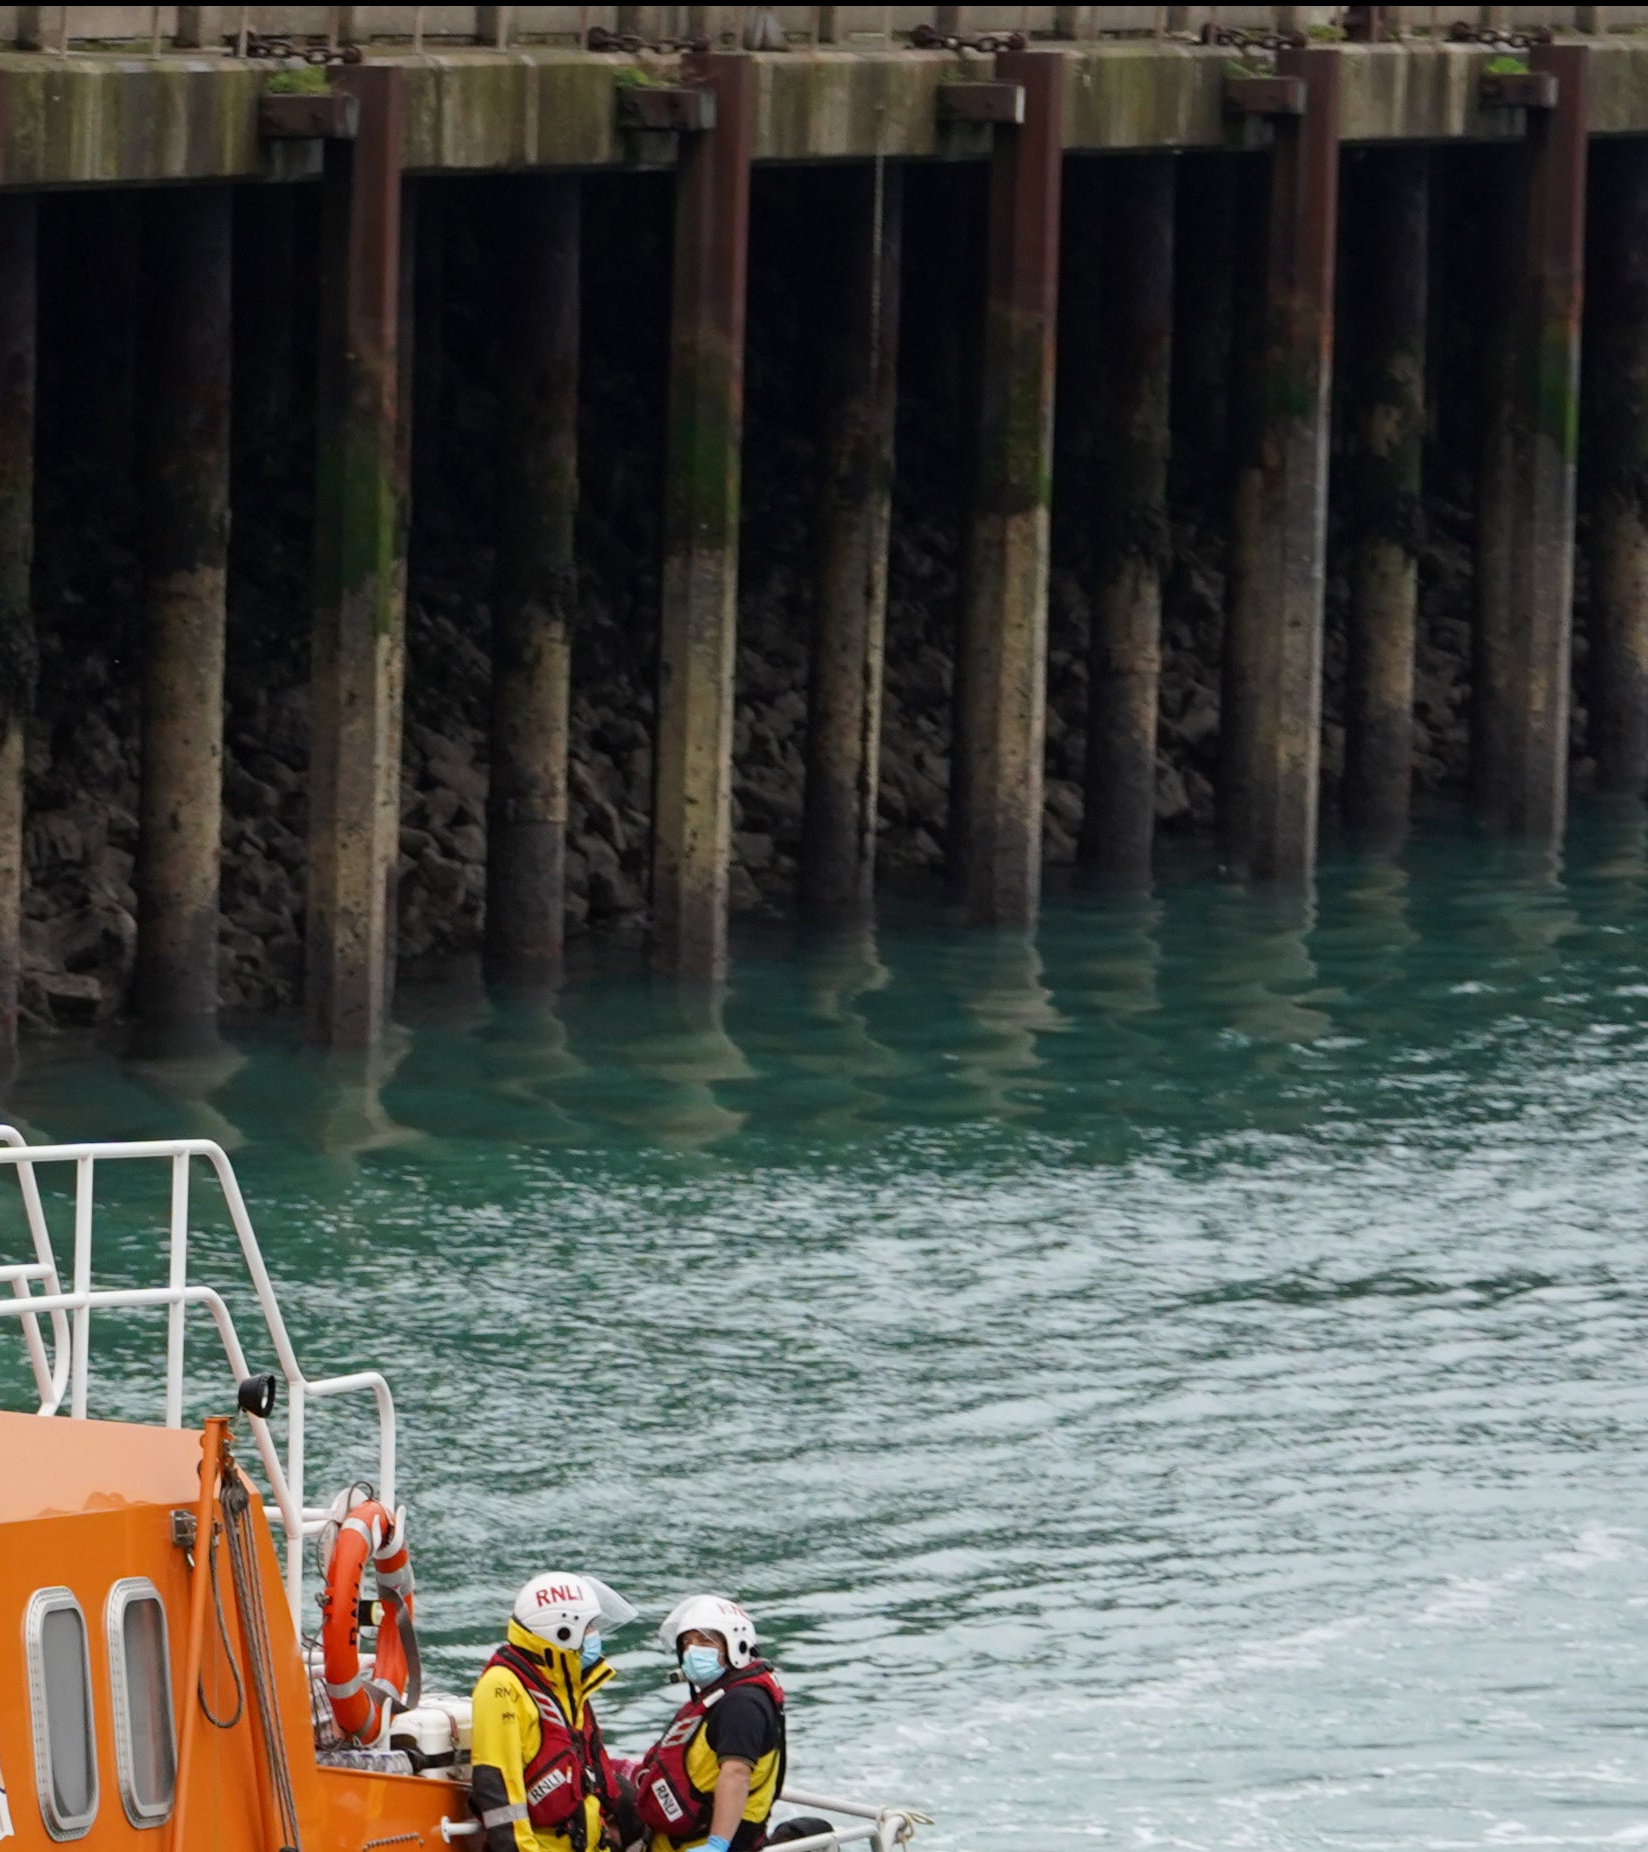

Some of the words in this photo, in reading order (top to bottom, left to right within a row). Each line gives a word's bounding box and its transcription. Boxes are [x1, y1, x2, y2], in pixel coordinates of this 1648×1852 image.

[535, 1584, 585, 1608] RNLI
[530, 1773, 562, 1801] RNLI
[655, 1784, 682, 1817] RNLI
